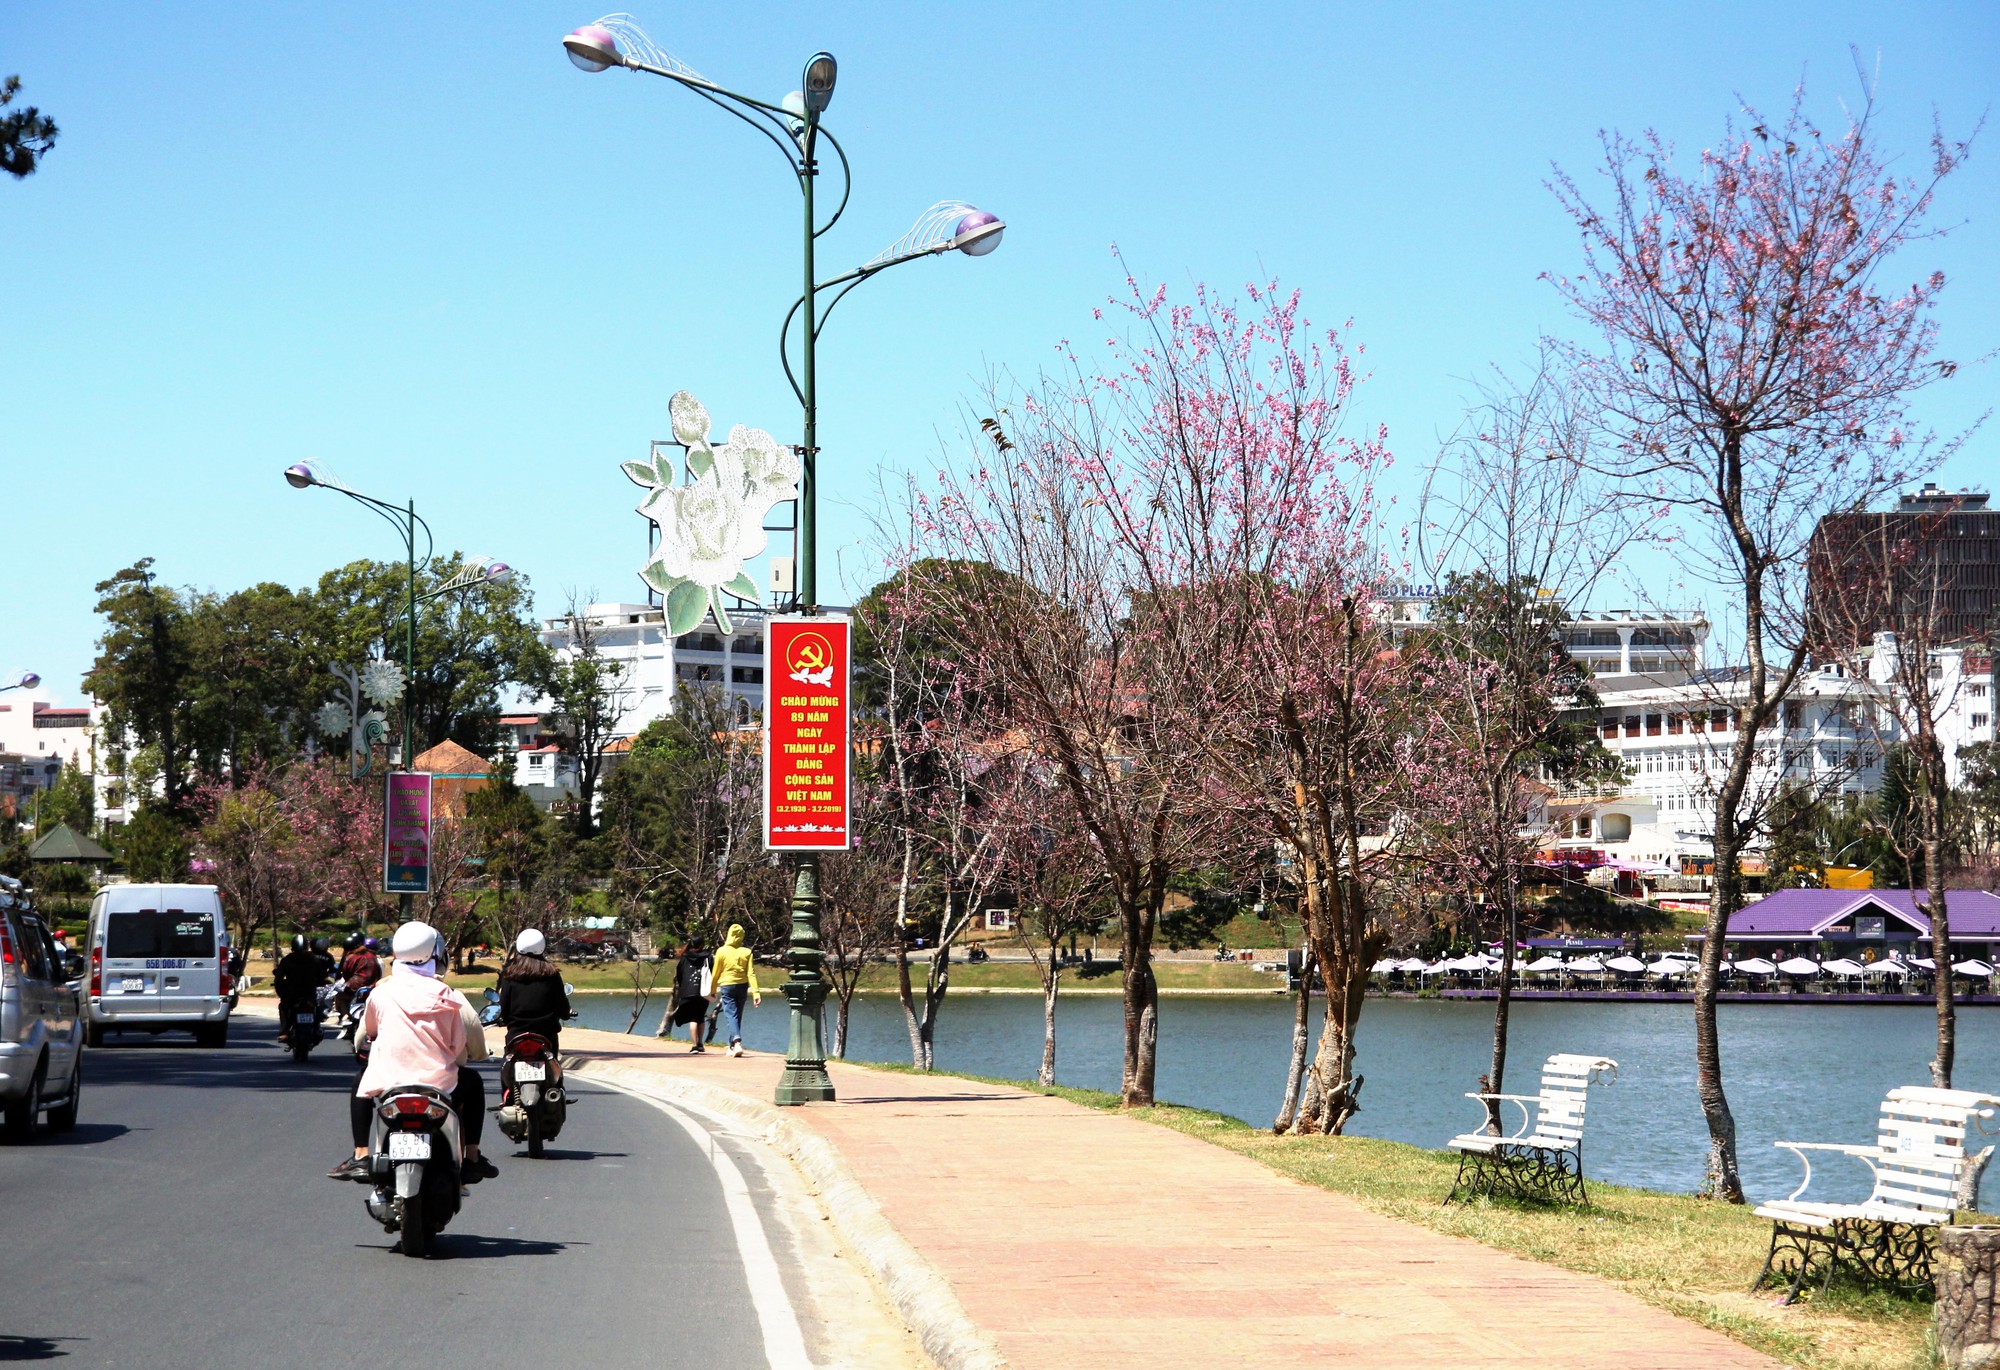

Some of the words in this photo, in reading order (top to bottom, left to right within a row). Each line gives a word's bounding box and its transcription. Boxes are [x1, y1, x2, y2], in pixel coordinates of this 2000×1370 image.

[781, 695, 807, 706] CHÀO
[810, 695, 839, 706] MỪNG
[791, 712, 804, 722] 89
[807, 711, 828, 722] NĂM
[797, 727, 822, 738] NGÀY
[783, 742, 815, 753] THÀNH
[818, 742, 836, 755] LẬP
[796, 757, 822, 769] ĐẢNG
[785, 774, 812, 786] CỘNG
[814, 773, 834, 785] SẢN
[786, 789, 807, 802] VIỆT
[810, 791, 831, 801] NAM
[777, 805, 806, 813] (3.2.1930
[812, 805, 841, 813] 3.2.2019)
[146, 959, 160, 969] 65B
[162, 959, 187, 969] 006.87
